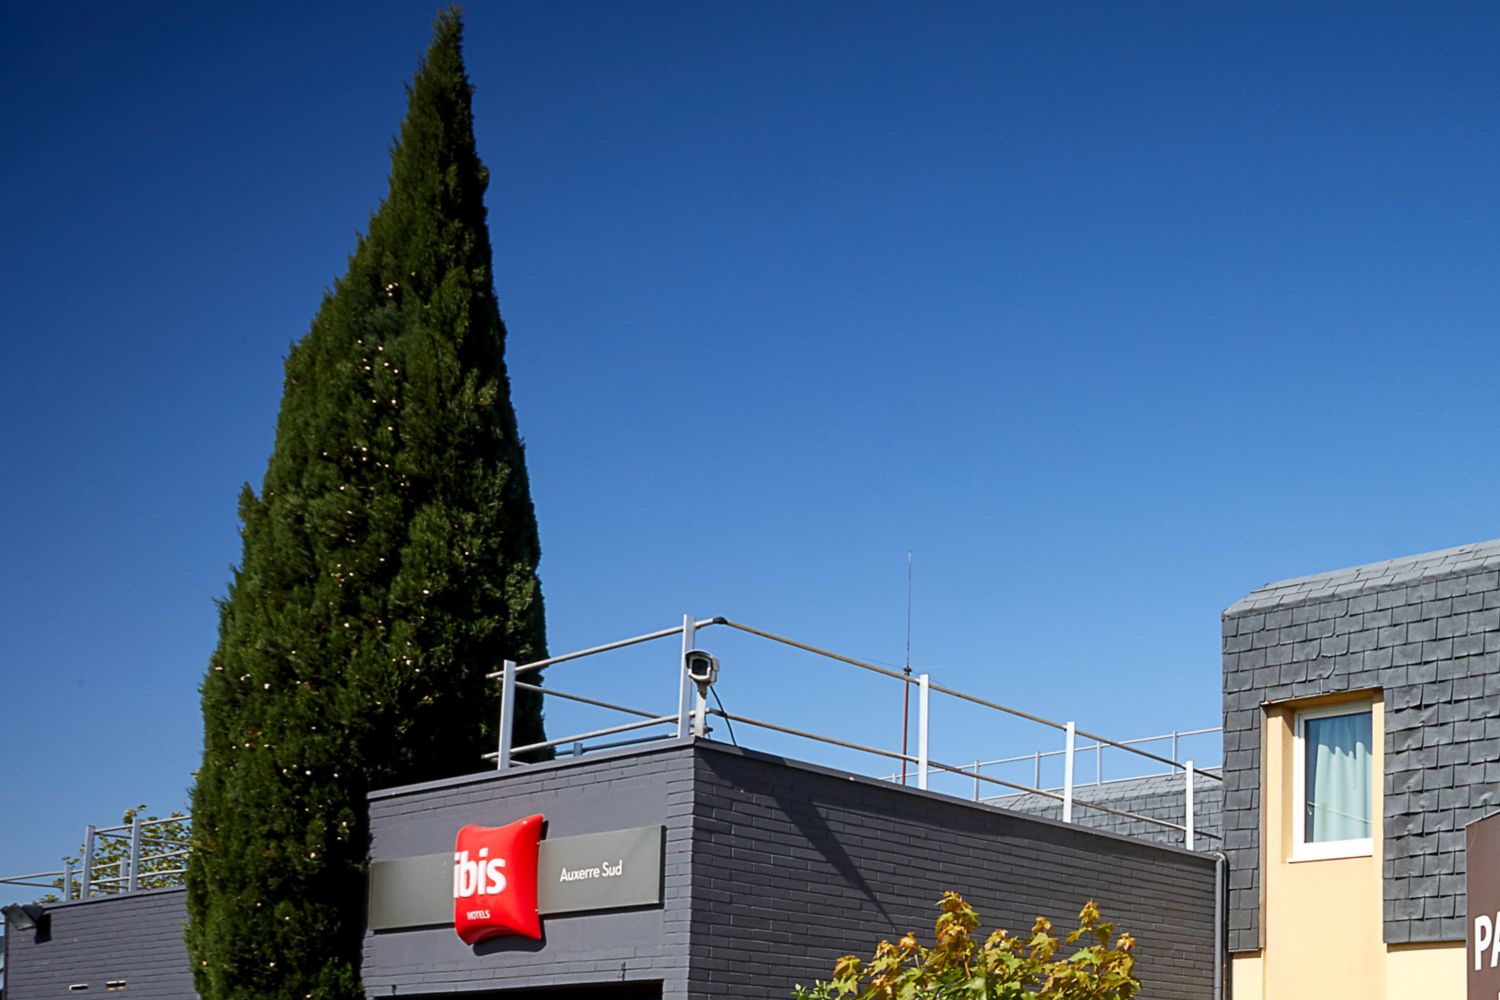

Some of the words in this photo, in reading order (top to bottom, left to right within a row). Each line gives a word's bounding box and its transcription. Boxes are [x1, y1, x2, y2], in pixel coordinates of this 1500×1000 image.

[453, 847, 507, 898] ibis
[560, 867, 600, 882] Auxerre
[602, 859, 622, 877] Sud
[466, 909, 490, 920] HOTELS
